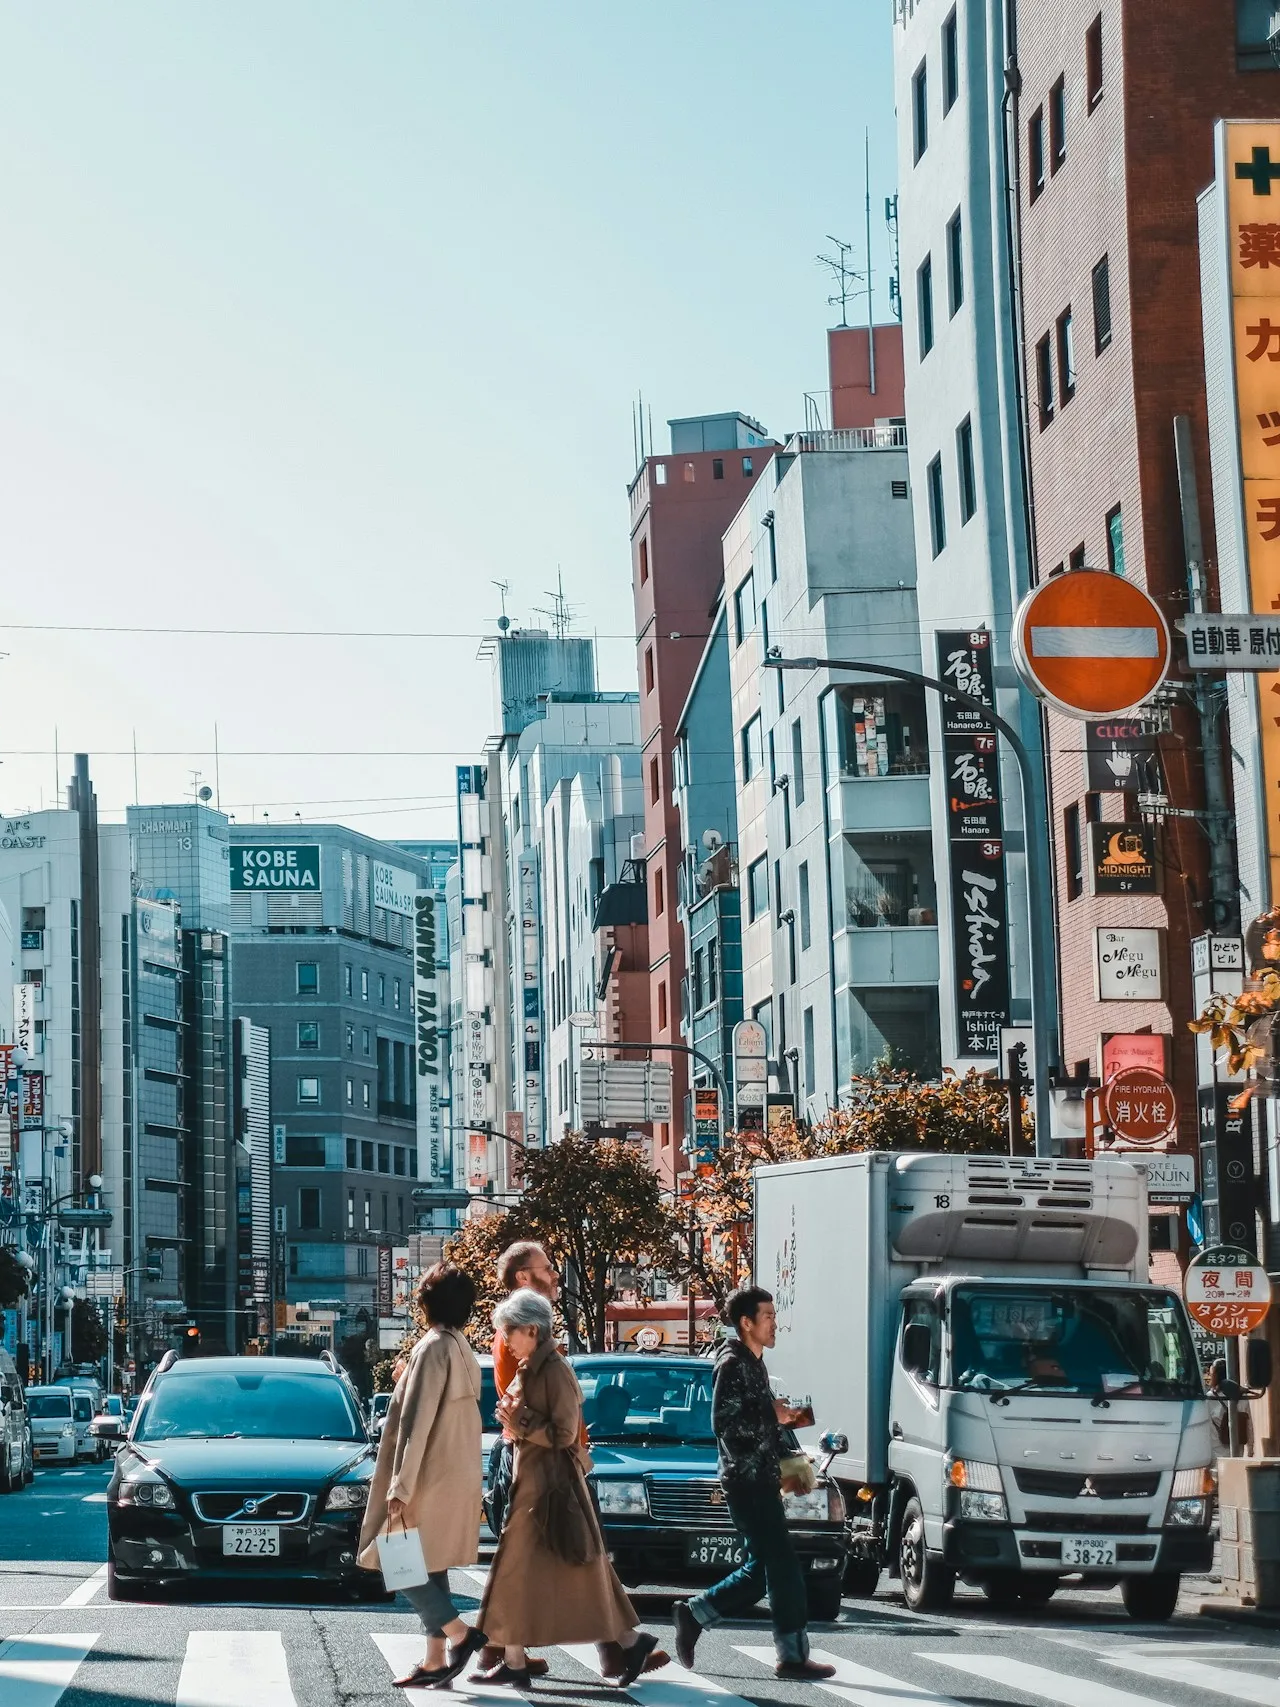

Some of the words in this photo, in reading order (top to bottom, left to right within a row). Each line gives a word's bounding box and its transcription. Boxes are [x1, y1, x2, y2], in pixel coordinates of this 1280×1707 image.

[970, 633, 987, 645] 8F
[956, 711, 981, 720] 石田屋
[947, 721, 992, 730] Hanareの上
[1096, 725, 1141, 738] CLICK
[976, 737, 994, 749] 7F
[1114, 779, 1127, 787] 6F
[962, 816, 987, 825] 石田屋
[139, 819, 193, 835] CHARMANT
[961, 825, 990, 835] Hanare
[177, 837, 193, 851] 13
[983, 843, 1000, 856] 3F
[242, 850, 298, 867] KOBE
[1097, 865, 1153, 874] MIDNIGHT
[243, 869, 316, 887] SAUNA
[375, 866, 393, 887] KOBE
[1120, 881, 1132, 890] 5F
[415, 895, 436, 980] HANDS
[961, 869, 1000, 1000] Ishida
[1106, 933, 1125, 943] Bar
[1212, 942, 1240, 952] かどや
[1217, 954, 1236, 964] ビル
[961, 1010, 1006, 1019] 神戸牛すてーき
[418, 988, 439, 1077] TOKYU
[966, 1021, 1002, 1033] Ishida
[968, 1034, 999, 1052] 本店
[1112, 1047, 1127, 1056] Live
[1130, 1047, 1154, 1056] Music
[1115, 1085, 1131, 1094] FIRE
[1132, 1085, 1167, 1094] HYDRANT
[429, 1084, 438, 1112] STORE
[1115, 1101, 1167, 1124] 消火栓
[430, 1113, 438, 1133] LIFE
[430, 1137, 439, 1178] CREATIVE
[1148, 1162, 1178, 1170] OTEL
[1021, 1170, 1042, 1178] Topre
[933, 1194, 950, 1209] 18
[1206, 1253, 1248, 1265] 兵タク協
[1201, 1270, 1253, 1289] 夜間
[1205, 1290, 1225, 1299] 20時
[1237, 1290, 1251, 1299] 2時
[1196, 1303, 1262, 1317] タクシー
[1210, 1317, 1249, 1329] のりば
[1023, 1450, 1153, 1461] FUSO
[235, 1538, 276, 1553] 22-25
[1073, 1549, 1113, 1565] 38-22
